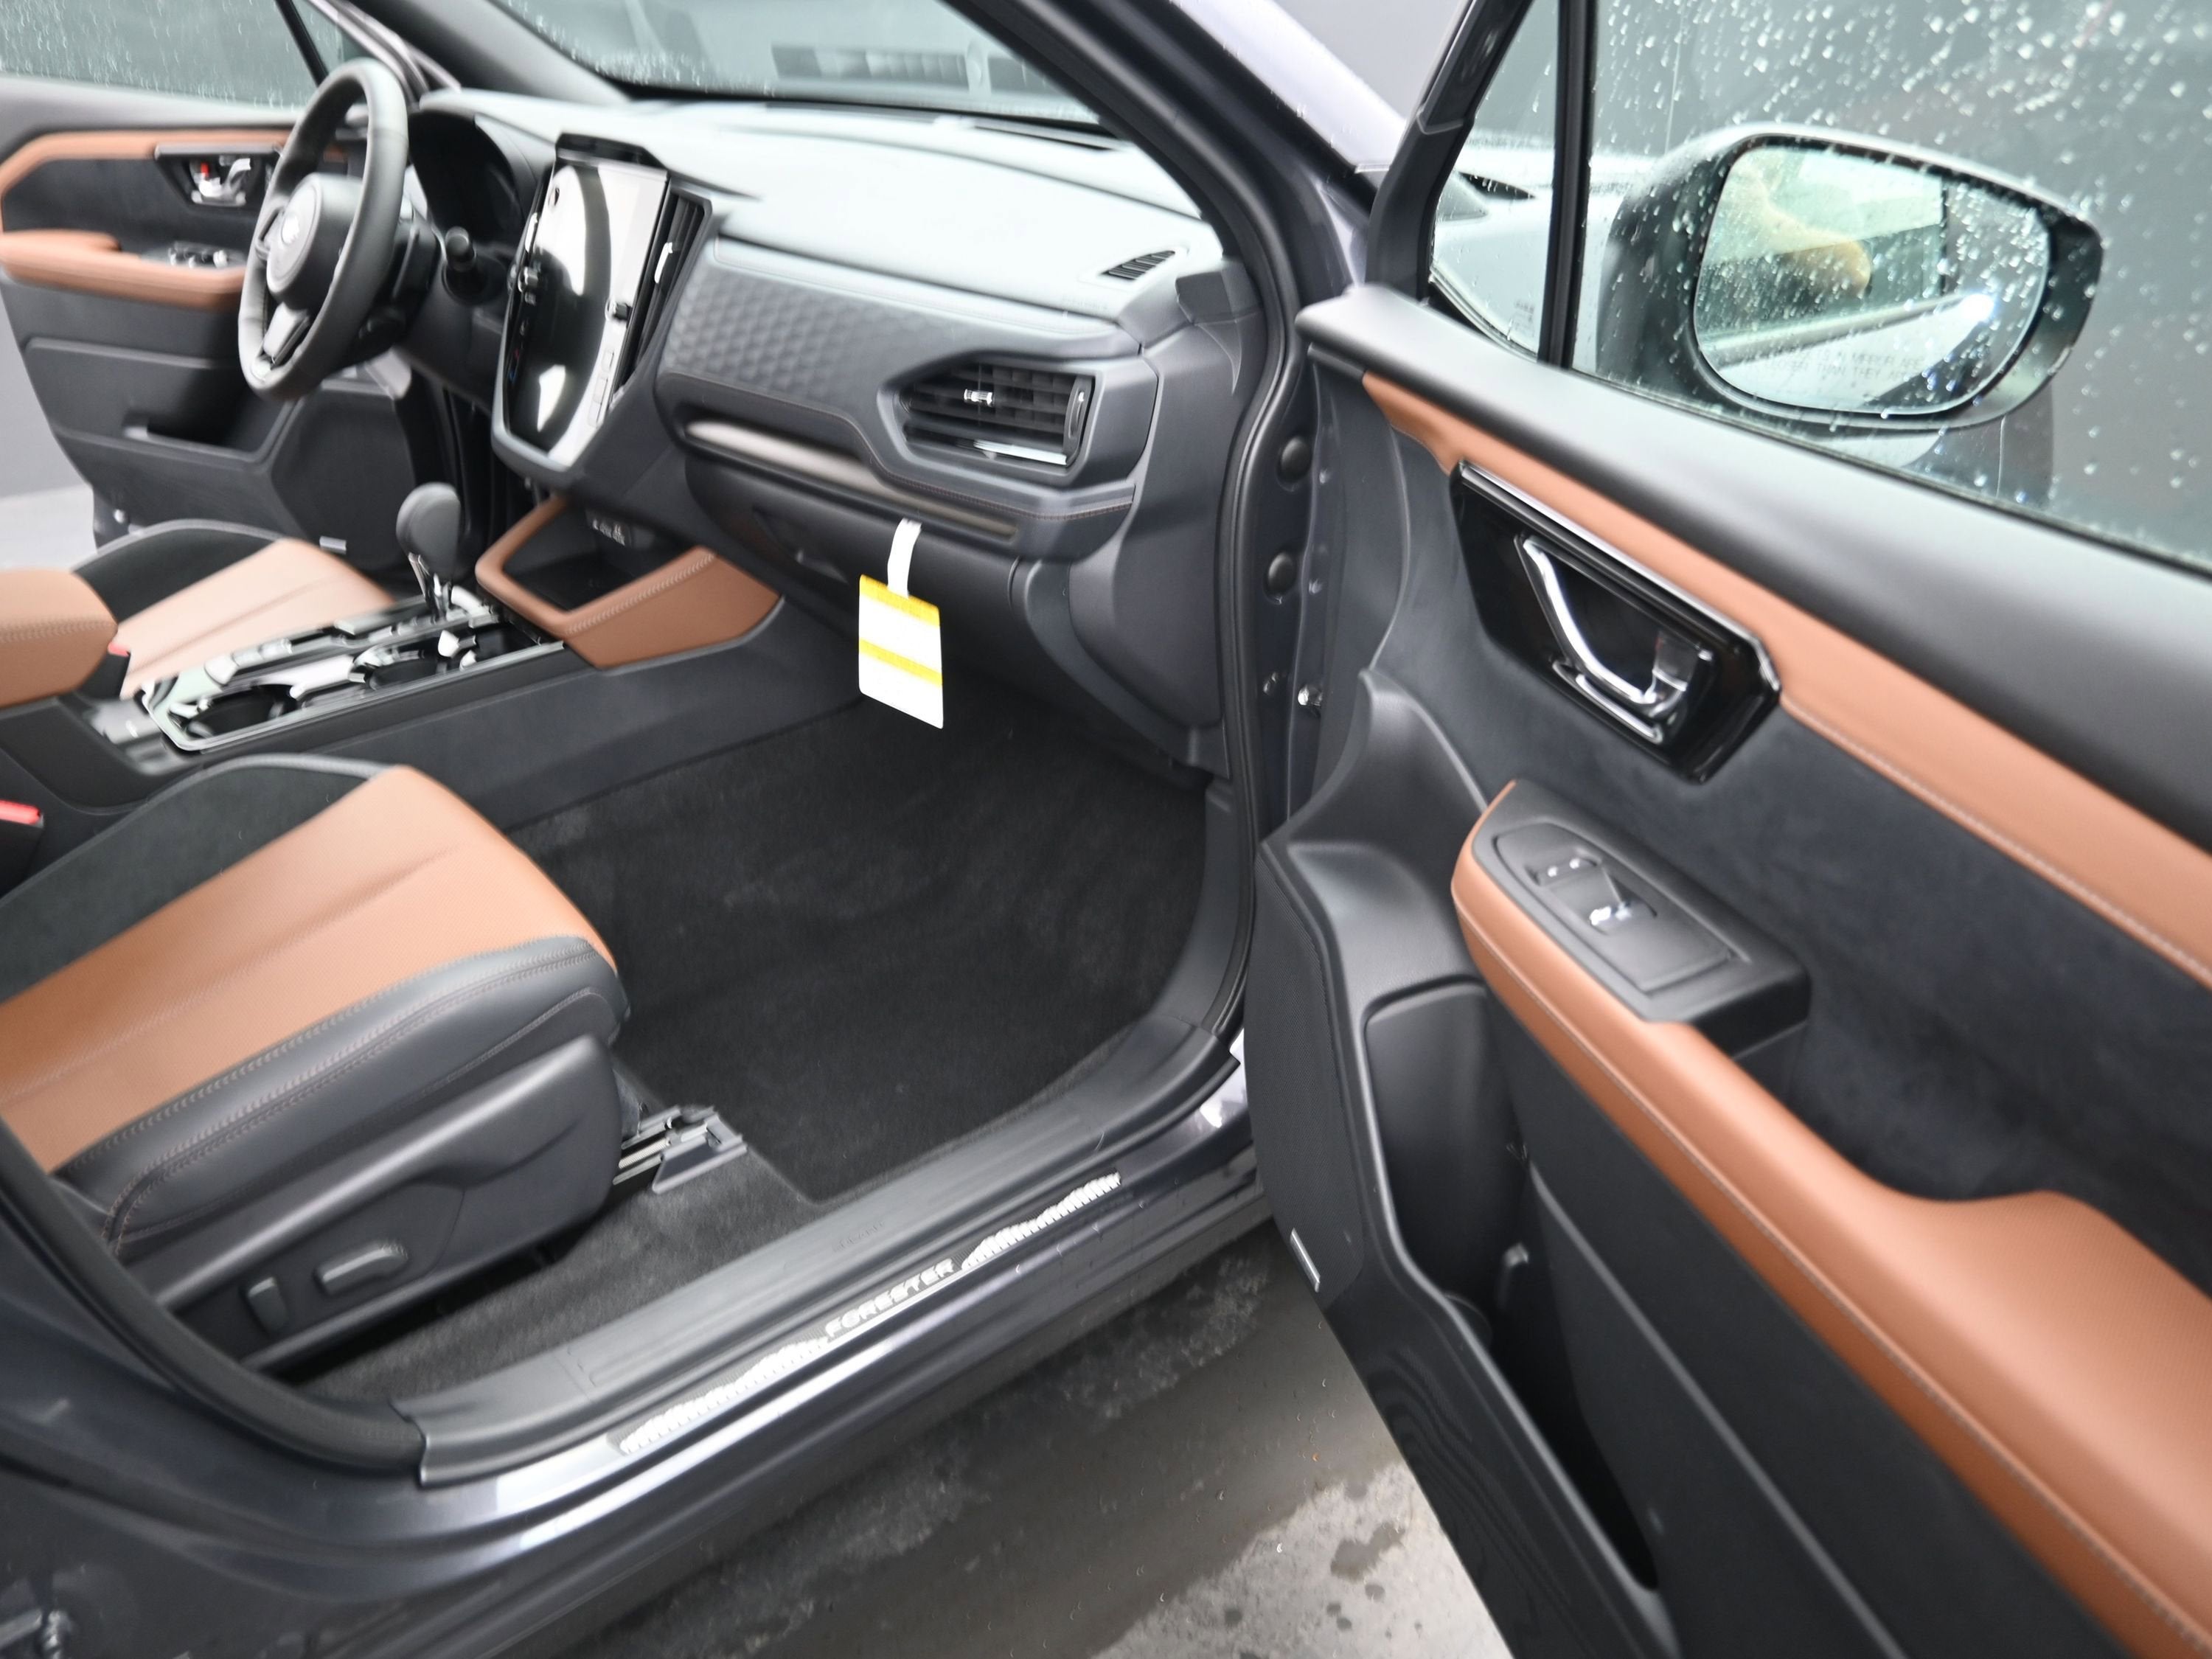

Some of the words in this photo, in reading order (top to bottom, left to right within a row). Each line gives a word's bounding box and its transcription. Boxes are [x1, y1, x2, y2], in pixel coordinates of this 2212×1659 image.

[1852, 352, 1896, 365] MIRROR
[1816, 362, 1846, 375] THAN
[1854, 366, 1882, 379] THEY
[825, 1258, 954, 1338] FORESTER
